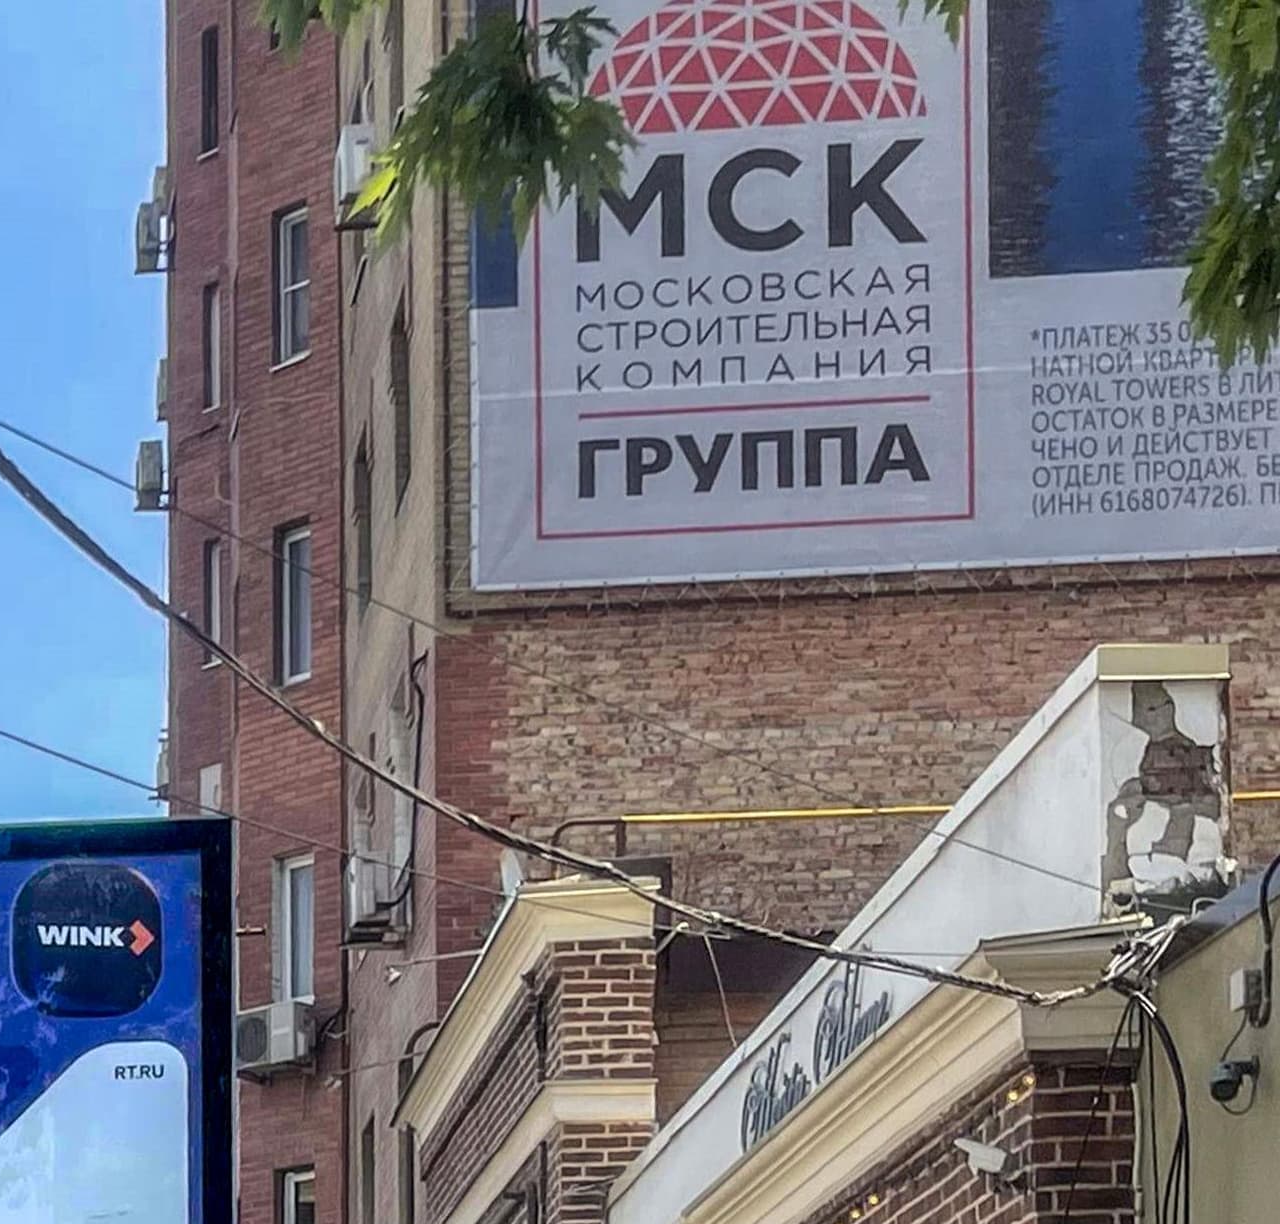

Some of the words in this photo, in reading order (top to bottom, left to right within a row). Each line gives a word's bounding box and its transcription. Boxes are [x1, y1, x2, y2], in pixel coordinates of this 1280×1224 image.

[576, 138, 928, 263] МСК
[576, 264, 930, 312] МОСКОВСКАЯ
[577, 305, 931, 353] СТРОИТЕЛЬНАЯ
[576, 345, 931, 392] КОМПАНИЯ
[1031, 348, 1133, 378] НАТНОЙ
[1031, 381, 1107, 406] ROYAL
[1112, 375, 1211, 401] TOWERS
[1218, 372, 1232, 397] В
[1031, 406, 1144, 433] ОСТАТОК
[1152, 405, 1166, 427] В
[1173, 399, 1279, 426] РАЗМЕРЕ
[1031, 435, 1098, 461] ЧЕНО
[1107, 435, 1123, 457] И
[1132, 427, 1273, 459] ДЕЙСТВУЕТ
[578, 424, 931, 499] ГРУППА
[1031, 462, 1125, 490] ОТДЕЛЕ
[1031, 493, 1092, 518] (ИНН
[37, 925, 125, 947] WINK
[114, 1064, 165, 1080] RT.RU
